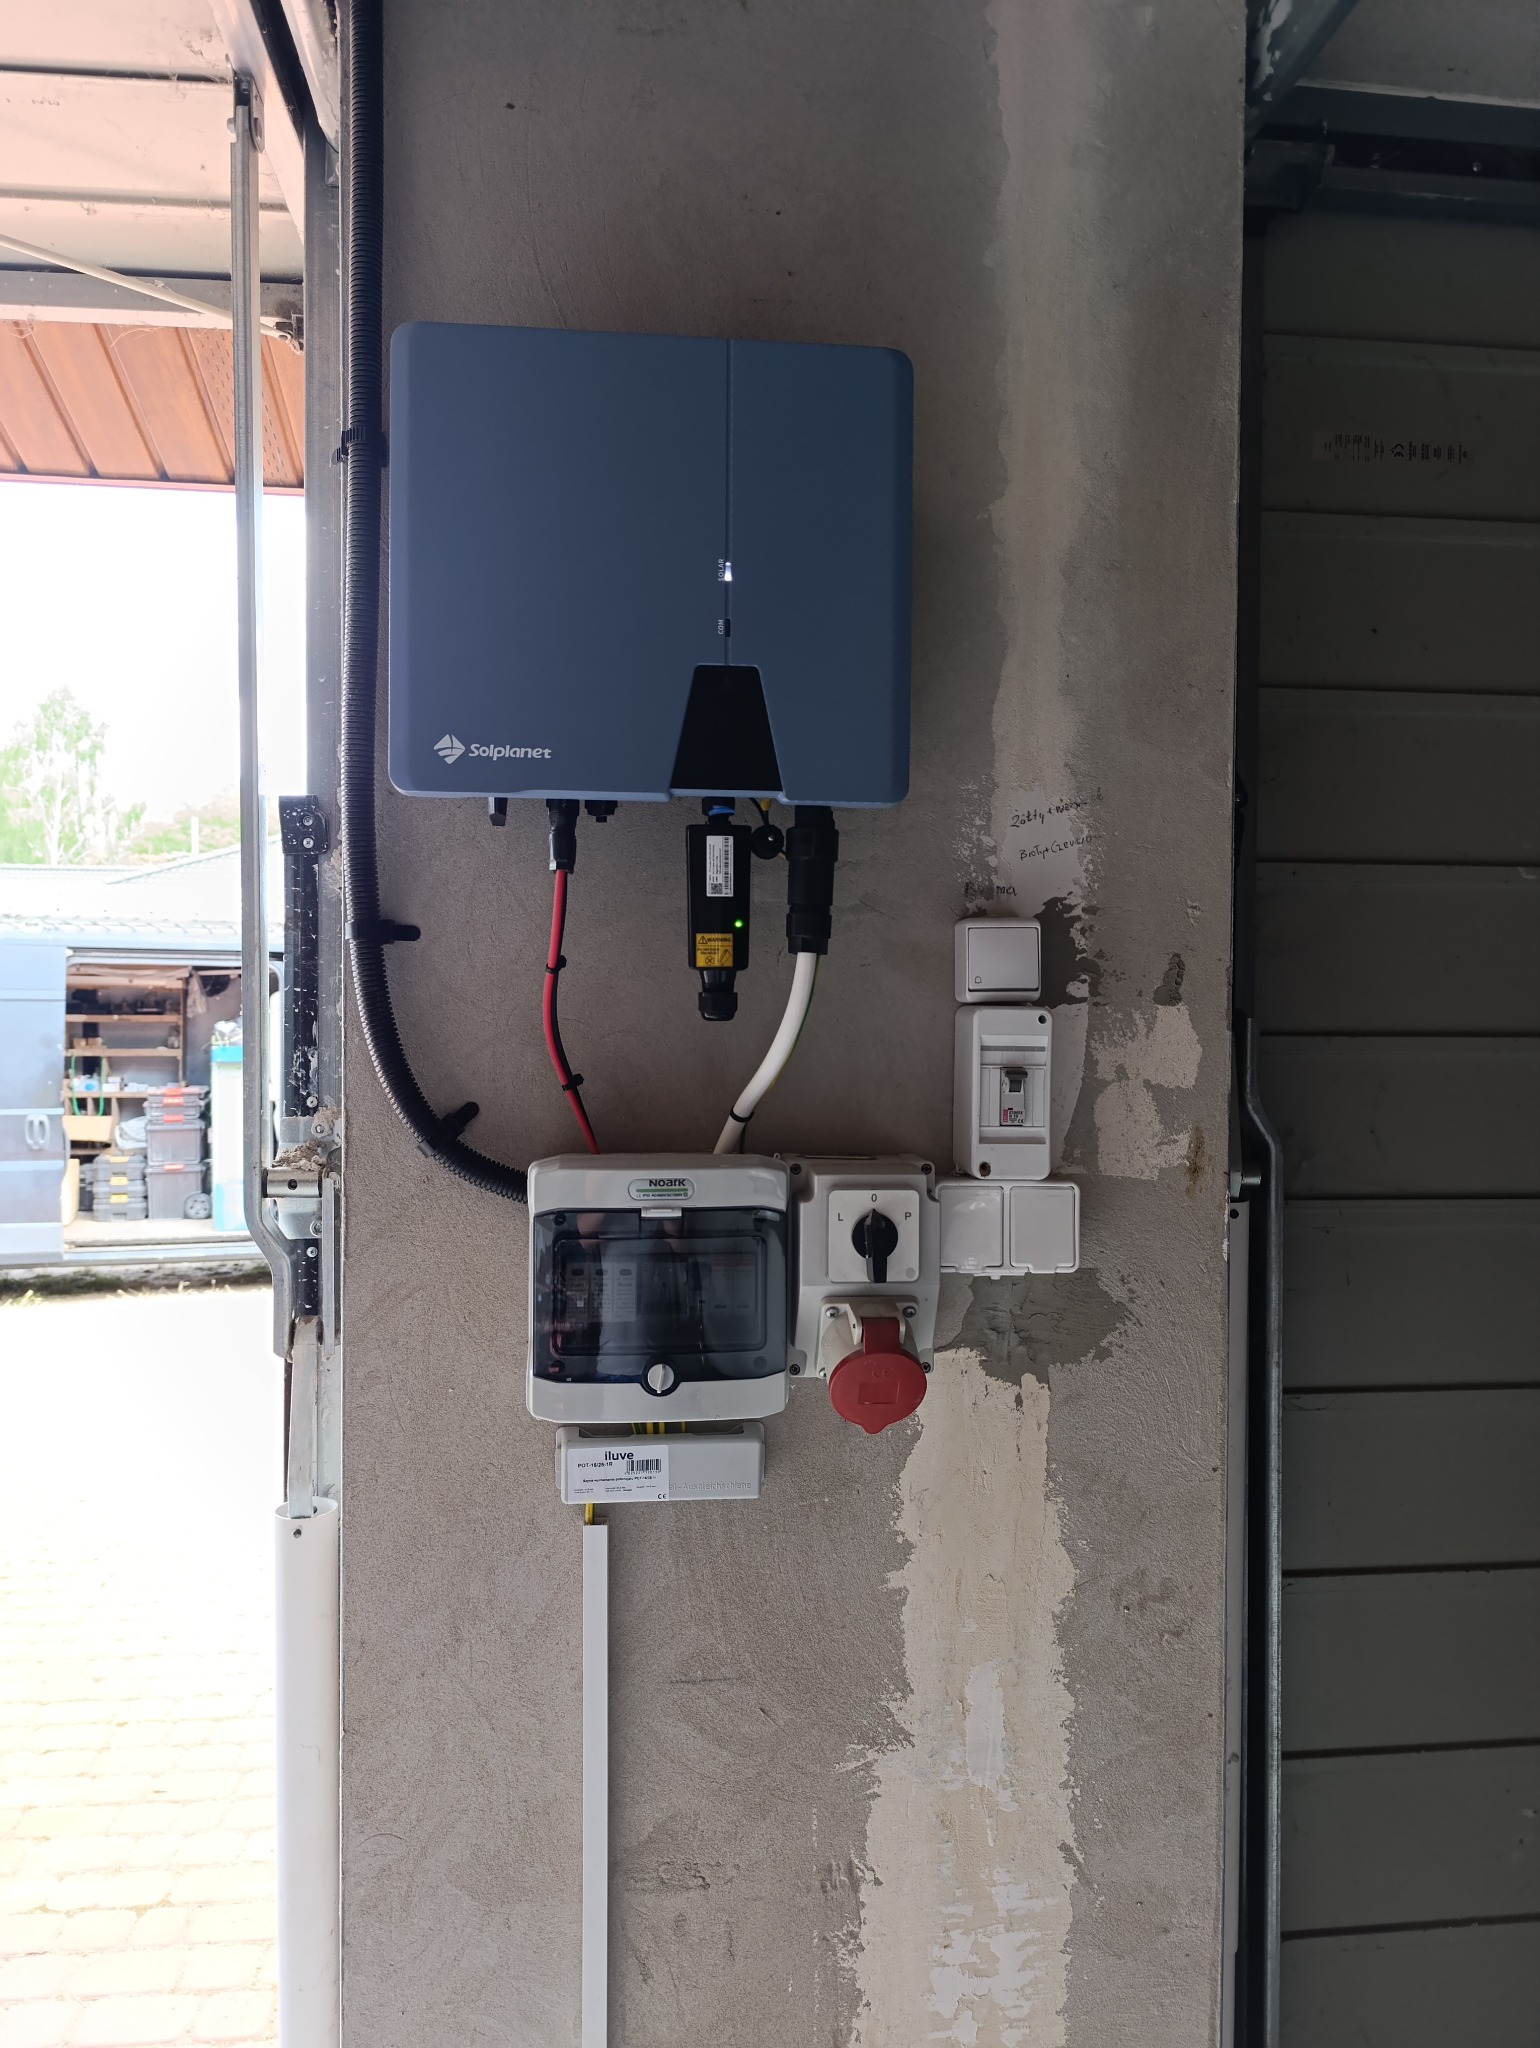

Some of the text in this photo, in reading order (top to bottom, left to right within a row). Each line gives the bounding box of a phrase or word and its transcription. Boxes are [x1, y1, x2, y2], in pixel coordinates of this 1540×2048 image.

[468, 743, 552, 761] Solplanet
[837, 1212, 844, 1221] L
[904, 1211, 911, 1220] P
[604, 1451, 634, 1461] iluve
